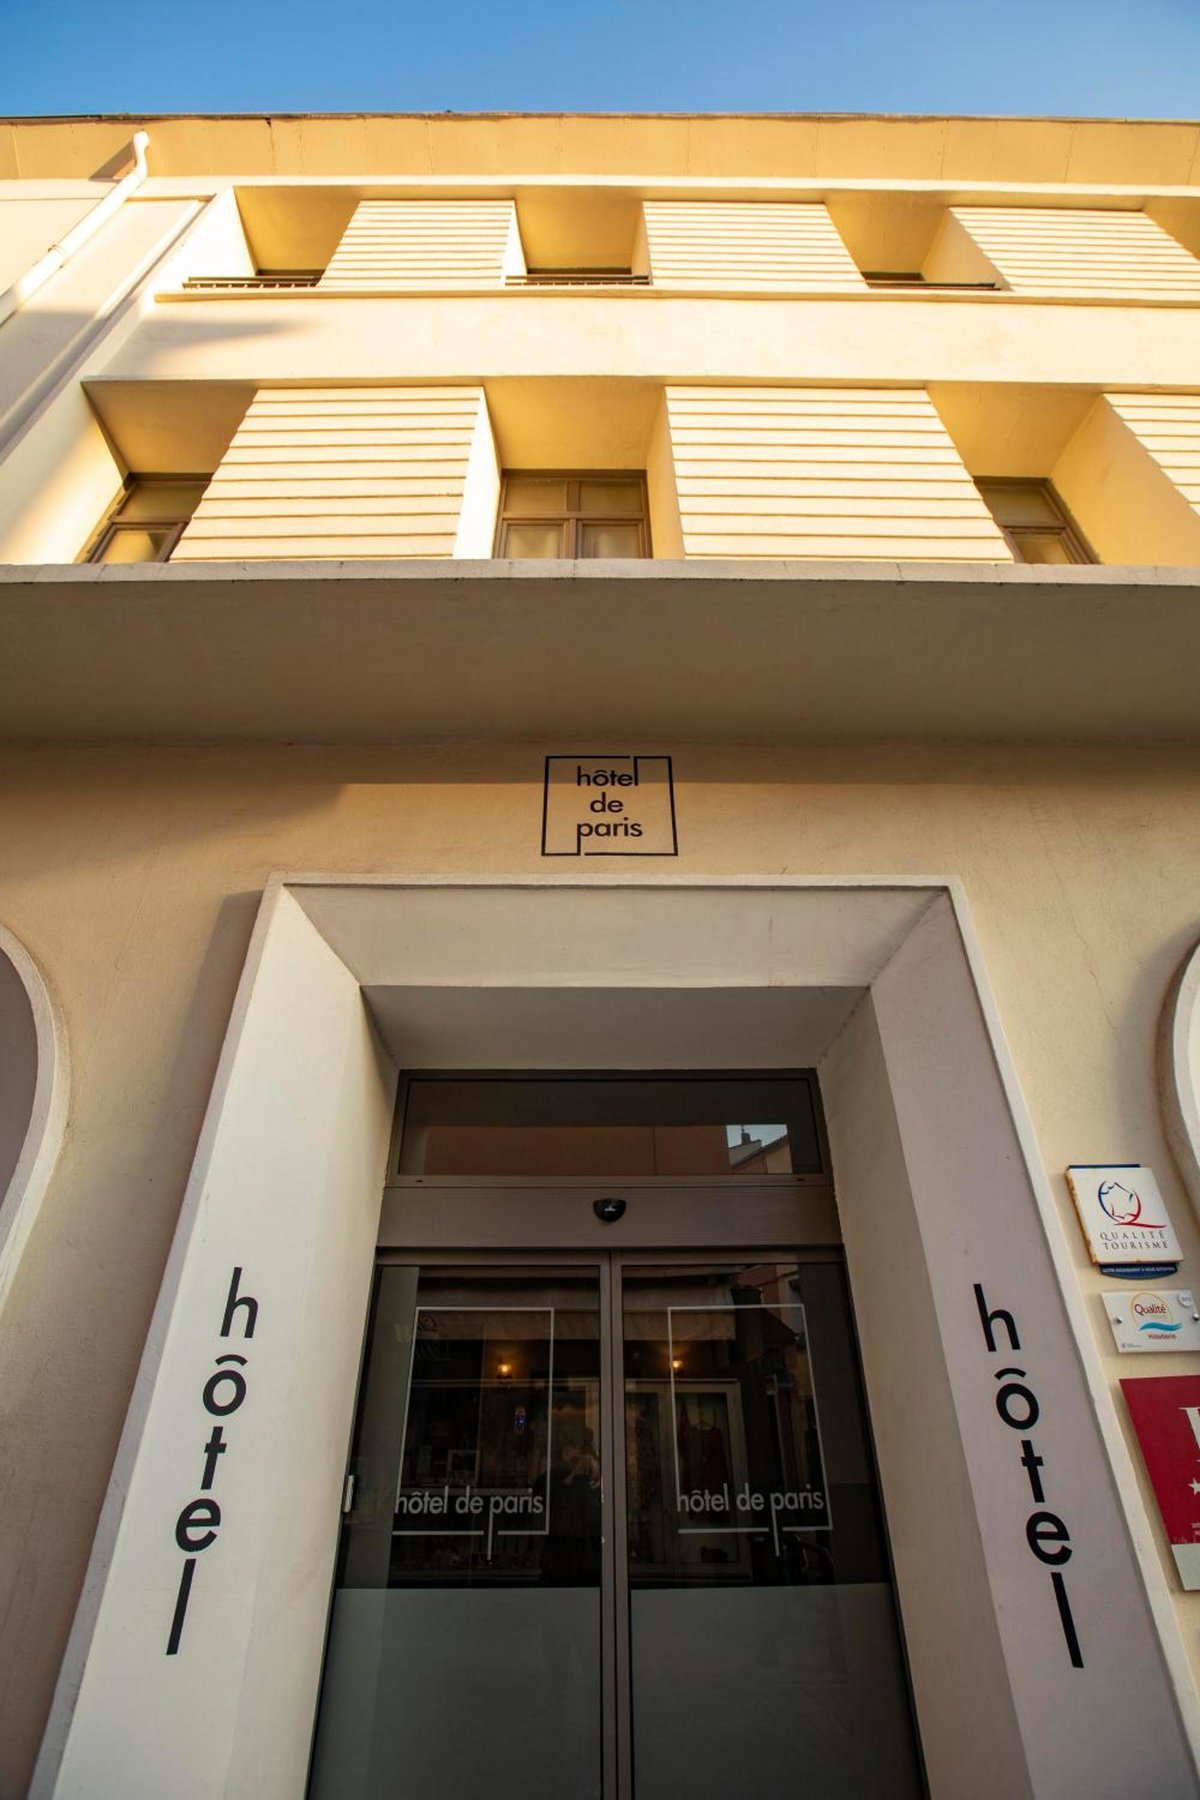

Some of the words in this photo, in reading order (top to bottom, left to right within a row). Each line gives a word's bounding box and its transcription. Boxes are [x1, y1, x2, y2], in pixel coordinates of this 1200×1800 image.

[577, 756, 639, 786] hôtel
[590, 792, 624, 813] de
[1104, 1241, 1168, 1250] TOURISME
[1134, 1303, 1168, 1316] Qualité
[166, 1266, 259, 1656] hôtel
[973, 1283, 1085, 1669] hôtel
[394, 1485, 449, 1514] hôtel
[455, 1485, 484, 1514] de
[676, 1483, 730, 1512] hôtel
[736, 1482, 766, 1511] de
